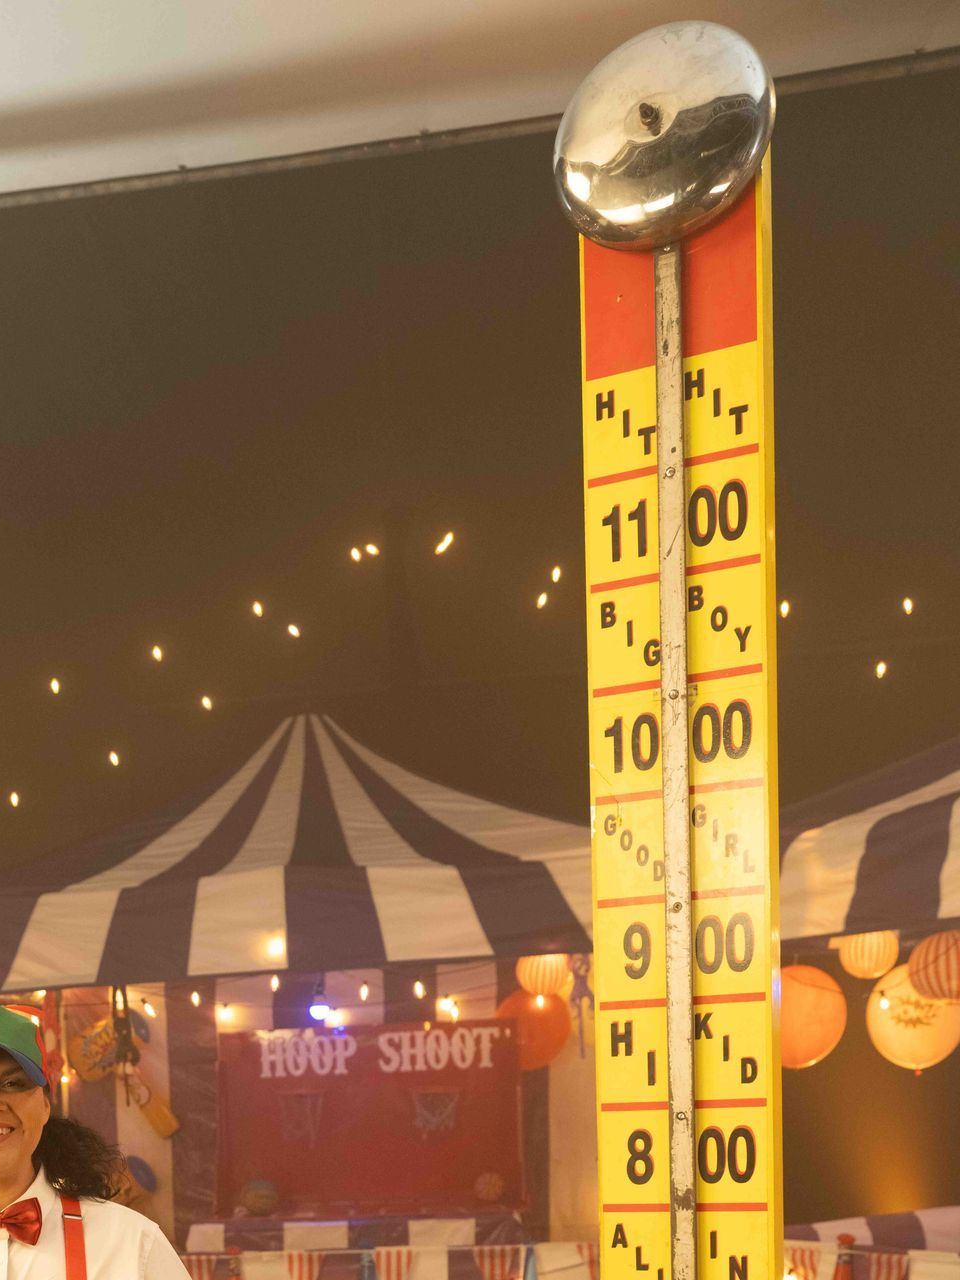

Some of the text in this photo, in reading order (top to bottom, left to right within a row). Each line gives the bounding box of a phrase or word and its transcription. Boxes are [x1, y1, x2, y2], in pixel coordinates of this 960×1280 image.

[596, 368, 749, 455] HIT HIT
[601, 478, 749, 562] 11 00
[600, 584, 752, 667] BIG BOY
[604, 698, 752, 773] 10 00
[604, 803, 755, 882] GOOD GIRL
[623, 912, 755, 980] 9 00
[259, 1028, 499, 1078] HOOP SHOOT
[611, 1012, 758, 1086] HI KID
[626, 1125, 757, 1185] 8 00
